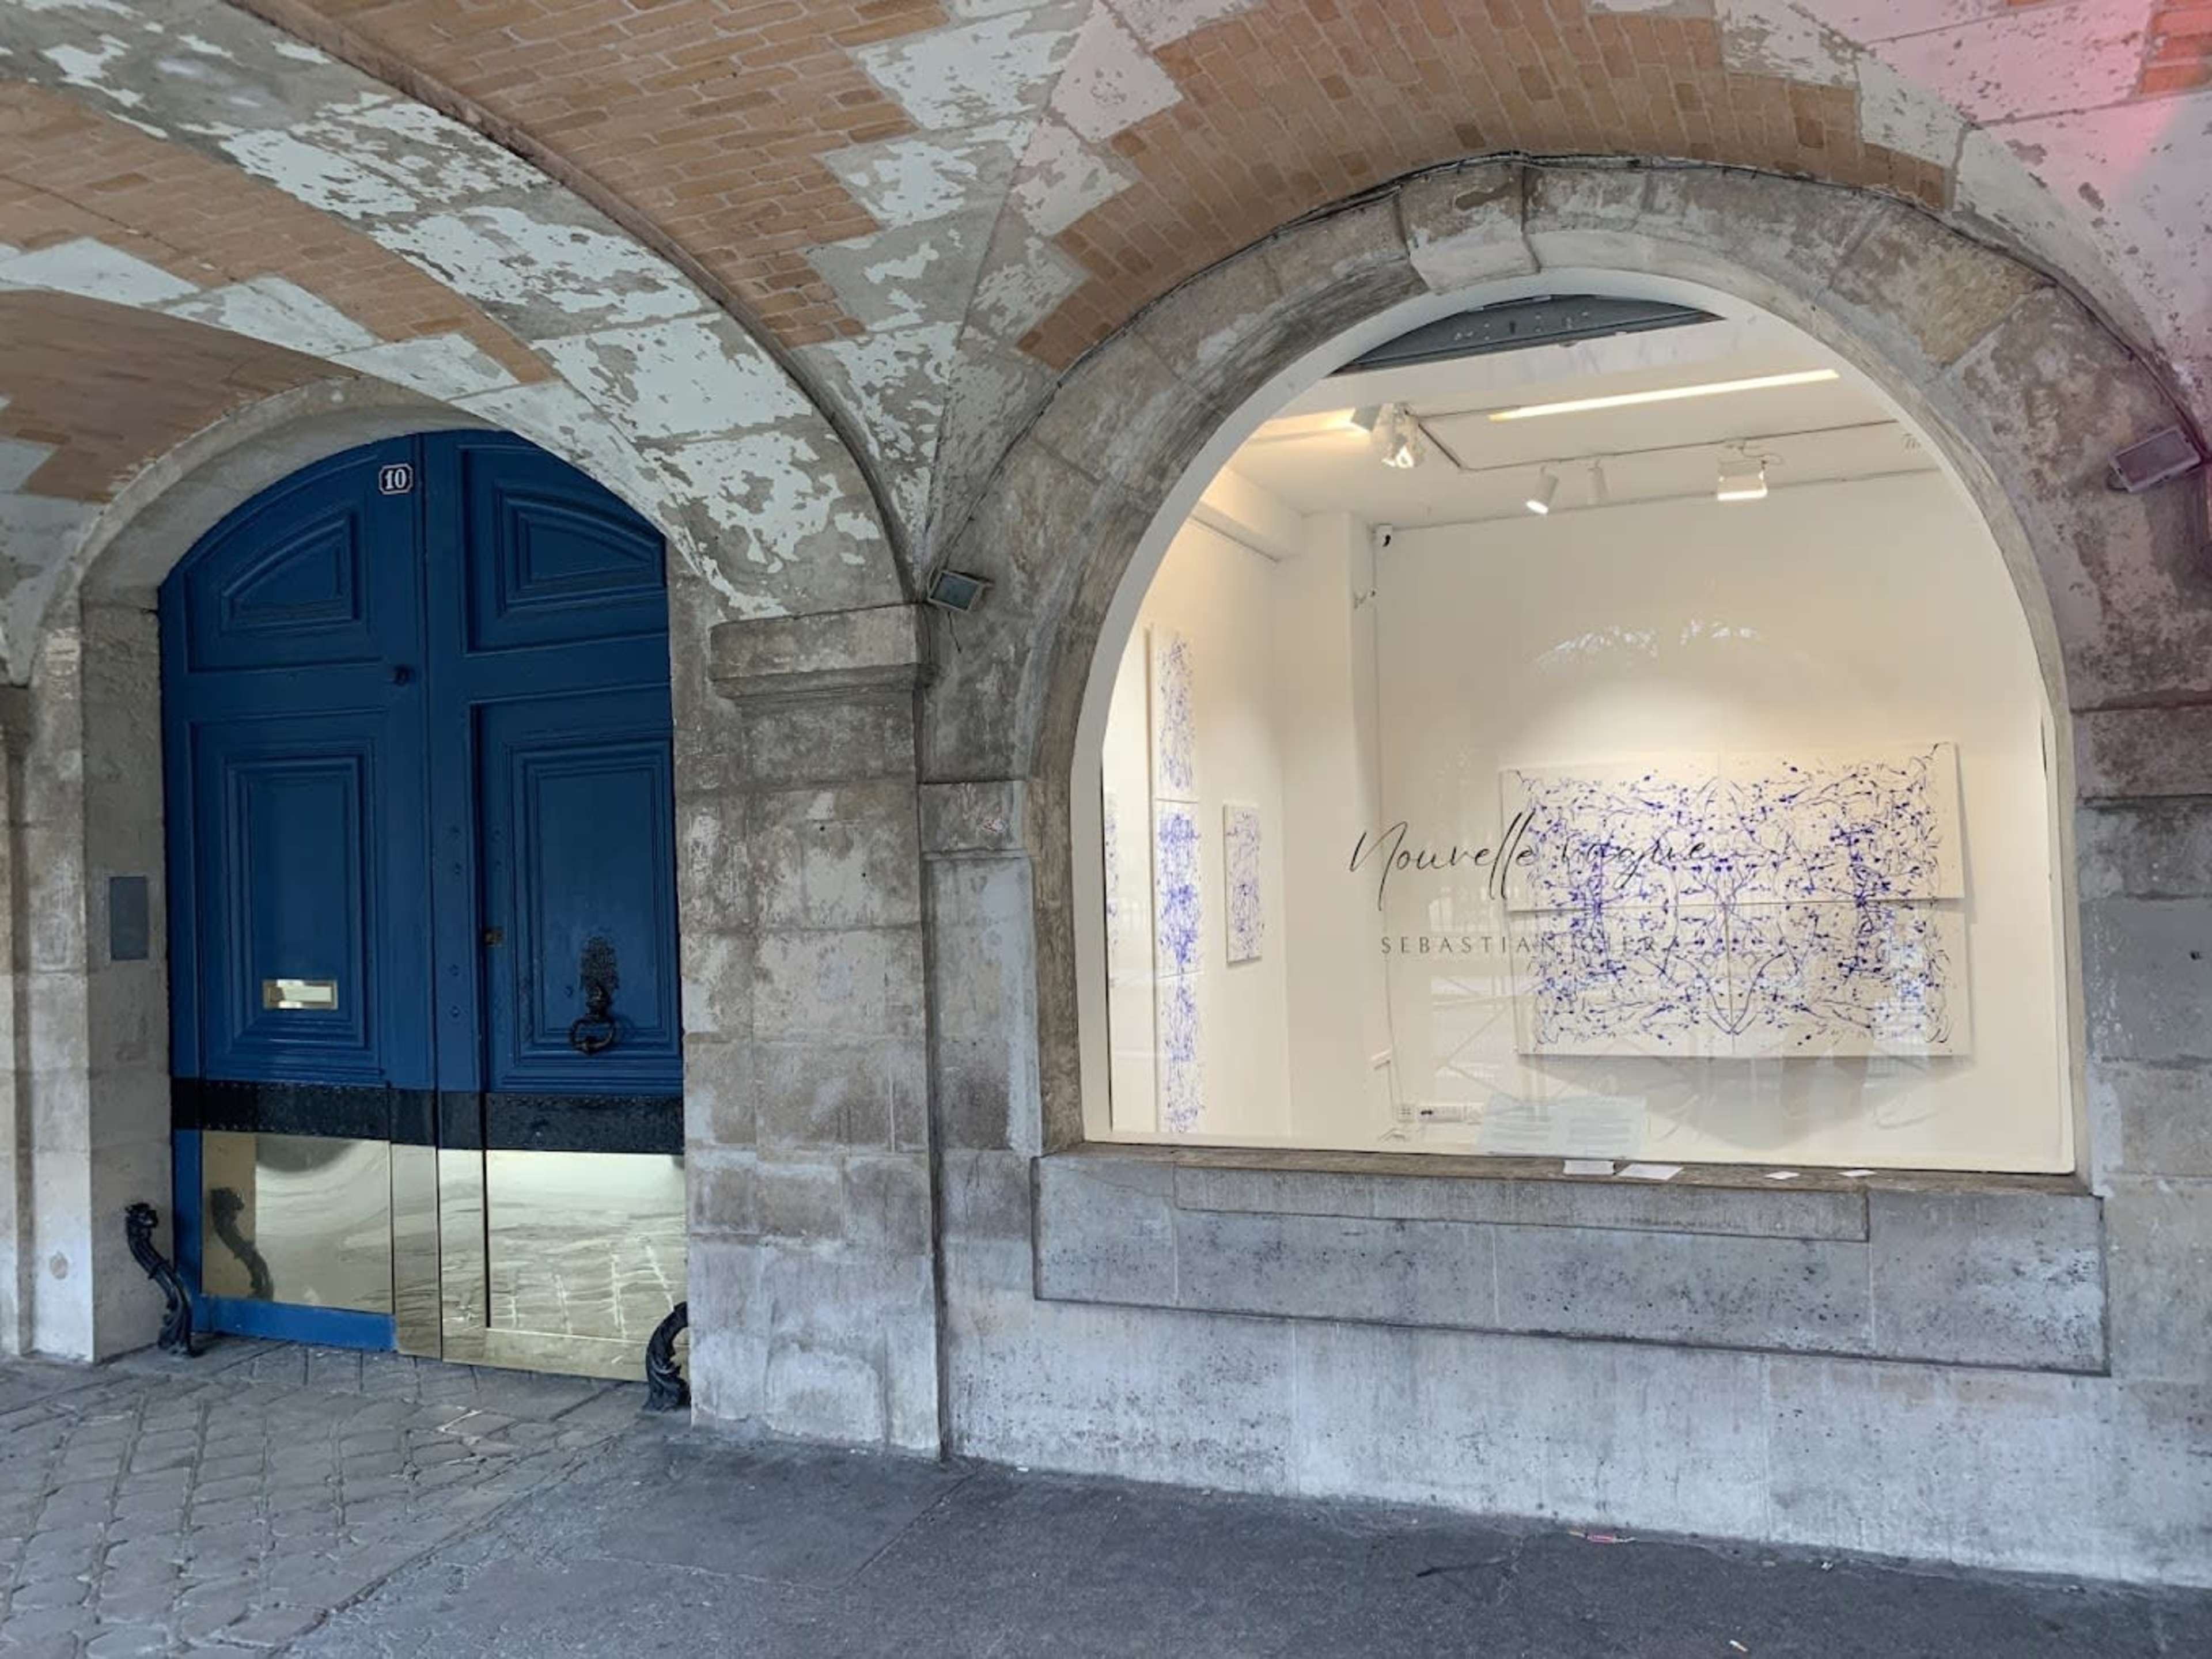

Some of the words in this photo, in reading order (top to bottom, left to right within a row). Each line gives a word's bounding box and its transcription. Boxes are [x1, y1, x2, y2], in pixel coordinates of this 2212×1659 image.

[385, 468, 407, 490] 10
[1350, 808, 1536, 911] Nouvelle
[1381, 936, 1555, 954] SEBASTIAN
